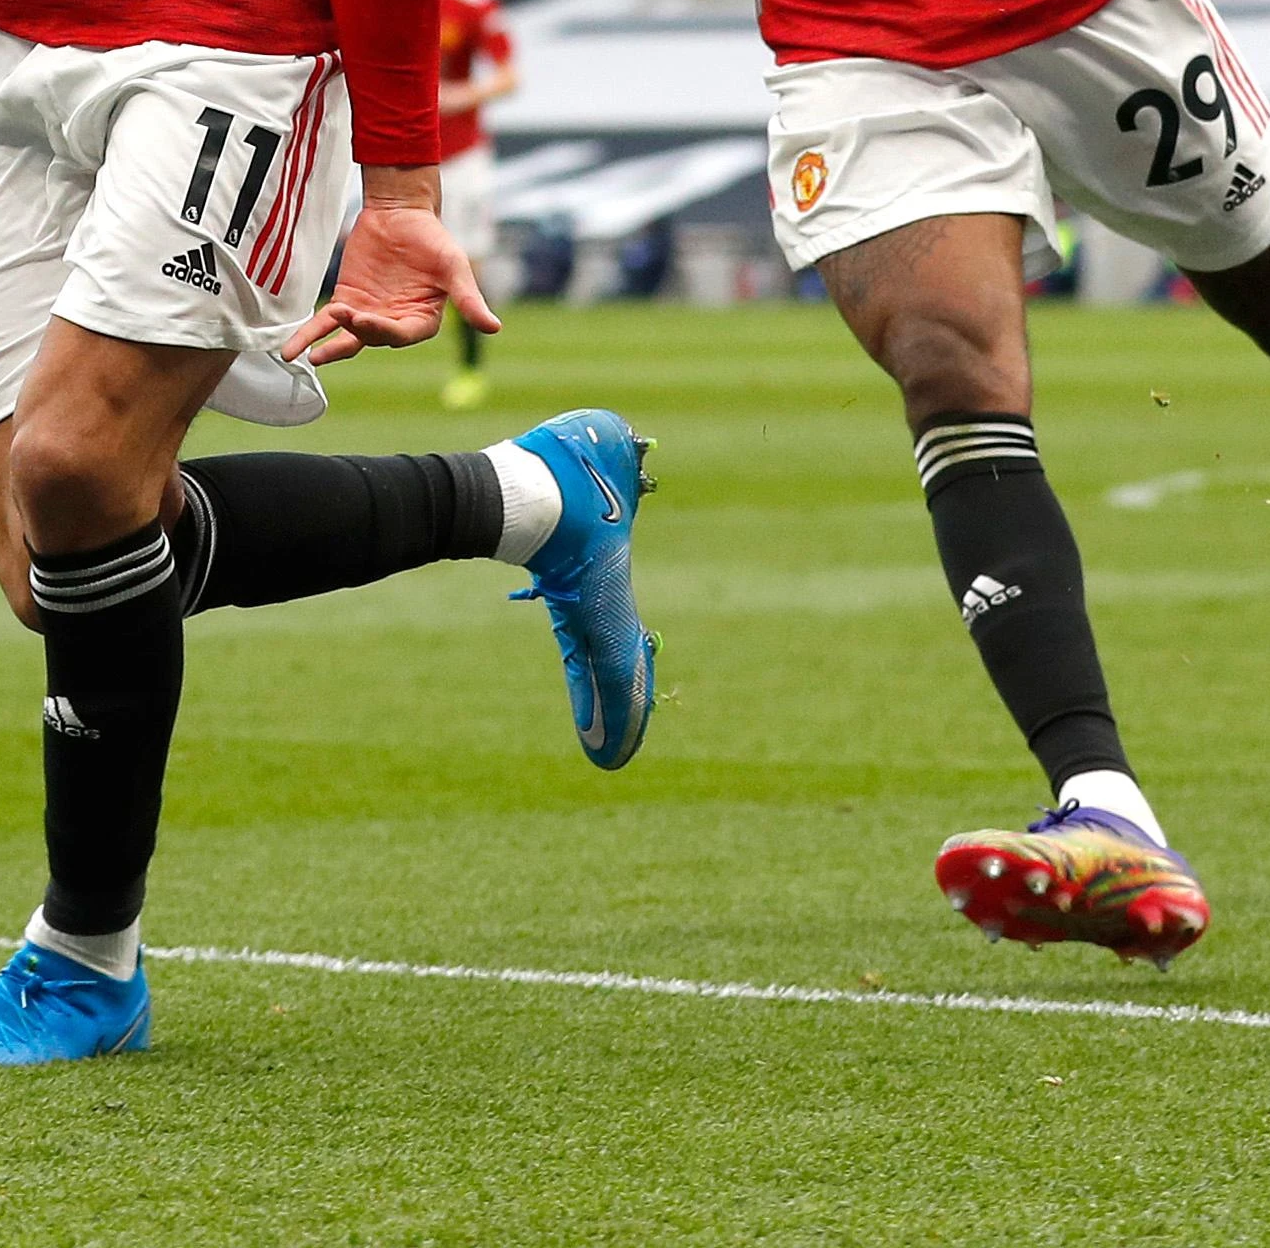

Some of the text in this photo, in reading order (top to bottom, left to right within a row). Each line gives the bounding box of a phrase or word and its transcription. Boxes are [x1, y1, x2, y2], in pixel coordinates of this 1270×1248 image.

[1115, 54, 1237, 187] 29
[180, 106, 281, 249] 11
[1223, 174, 1266, 212] adidas
[161, 262, 222, 296] adidas
